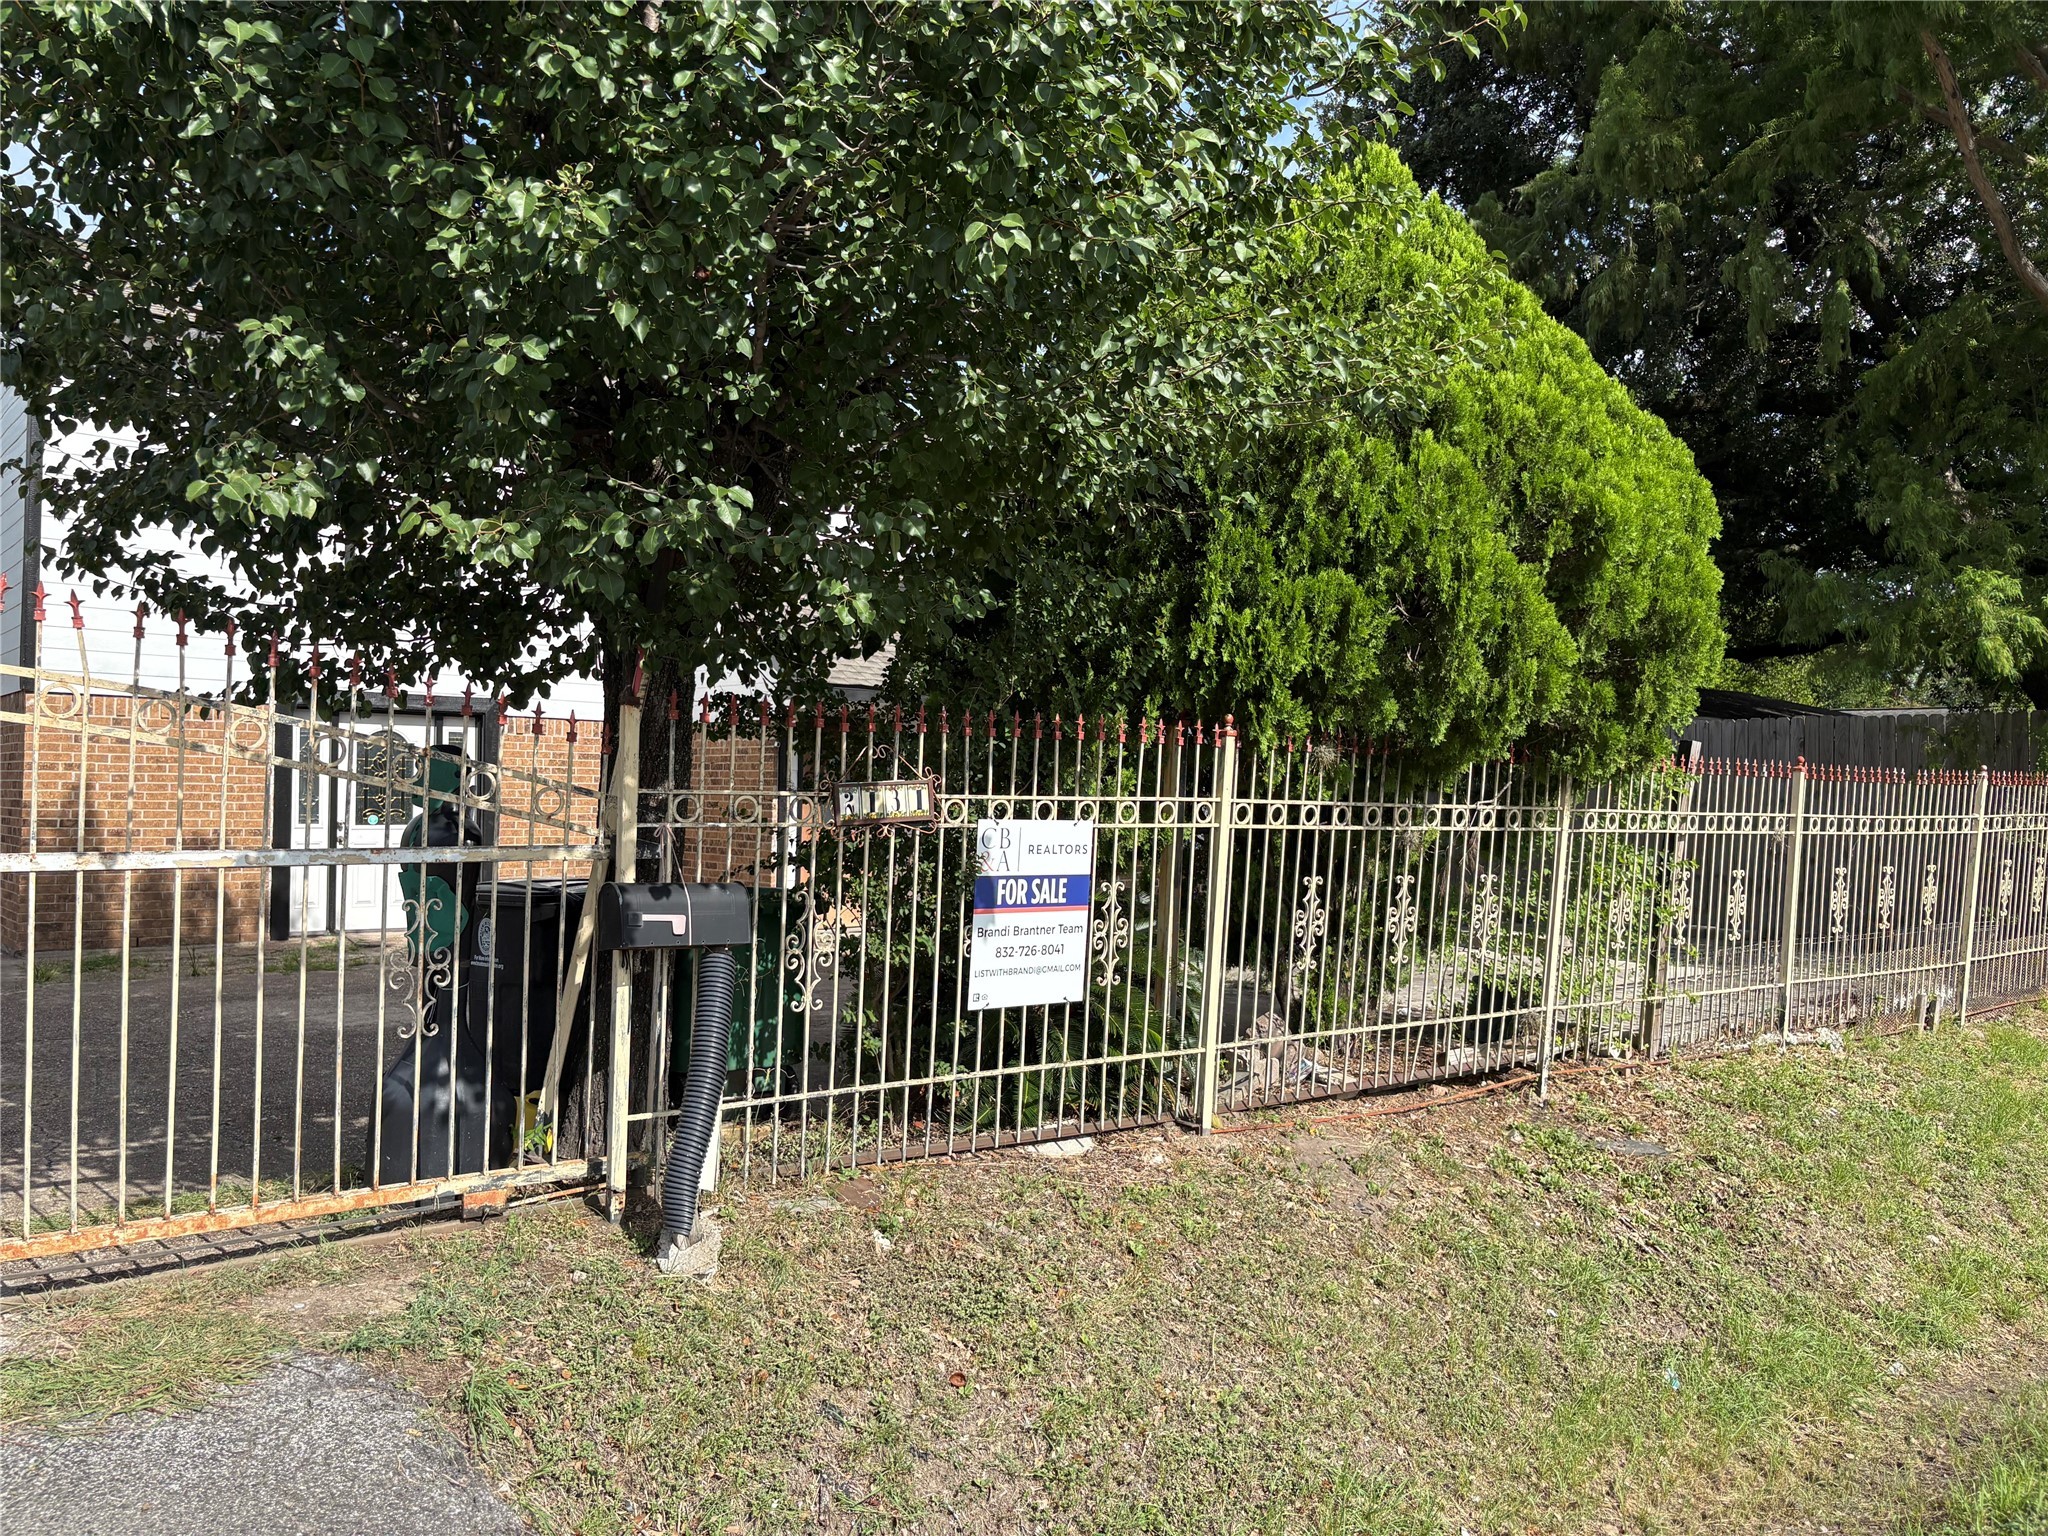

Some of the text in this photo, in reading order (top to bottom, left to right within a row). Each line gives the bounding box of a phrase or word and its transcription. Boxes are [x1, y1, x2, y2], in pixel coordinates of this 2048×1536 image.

[844, 789, 923, 815] 2131
[981, 827, 1011, 850] CB
[1028, 844, 1088, 855] REALTORS
[996, 877, 1068, 906] FOR SALE
[977, 923, 1084, 938] Brandi Brantner Team
[995, 943, 1065, 959] 832-726-8041
